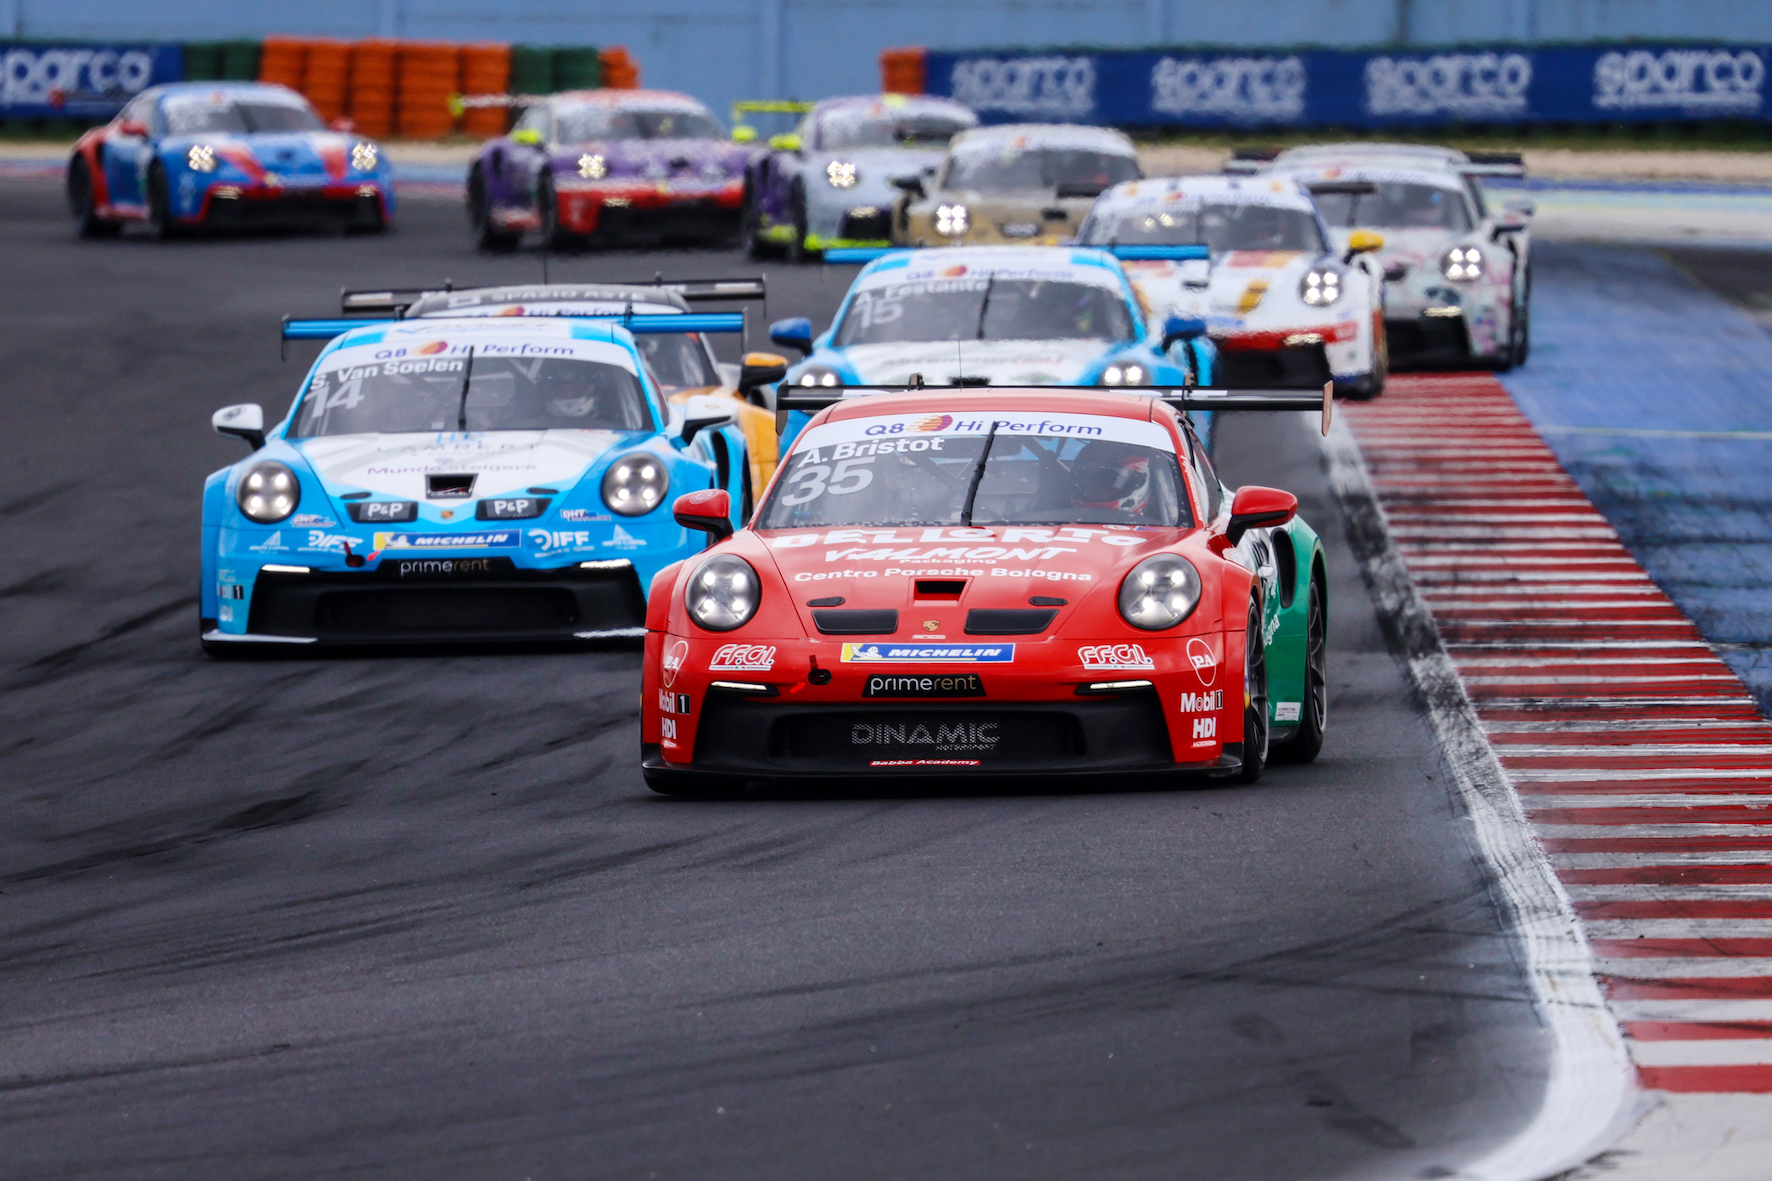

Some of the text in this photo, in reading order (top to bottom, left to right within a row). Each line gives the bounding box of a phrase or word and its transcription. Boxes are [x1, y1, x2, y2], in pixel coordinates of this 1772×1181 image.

[0, 50, 153, 106] parco
[1594, 50, 1765, 108] sparco
[851, 299, 904, 330] 15
[374, 343, 574, 358] Q8 H Perform
[337, 364, 379, 383] Van
[382, 358, 465, 377] Soelen
[304, 378, 366, 419] 14
[865, 420, 1103, 436] Q8 Hi Perform
[797, 436, 945, 468] A. Bristot
[781, 456, 877, 507] 35
[367, 502, 404, 518] P&P
[494, 499, 530, 516] P&P
[414, 533, 509, 546] MICHELIN
[824, 546, 1078, 563] VALMONT
[899, 557, 997, 565] Packaging
[400, 558, 490, 577] primerent
[794, 566, 1093, 582] Centro Porsche Bologna
[887, 648, 1003, 658] MICHELIN
[869, 674, 977, 696] primerent
[659, 688, 676, 714] Mobil
[1180, 690, 1216, 713] Mobil
[661, 717, 678, 740] HDI
[851, 722, 1001, 745] DINAMIC
[1192, 716, 1217, 739] HDI
[916, 759, 979, 767] Academy
